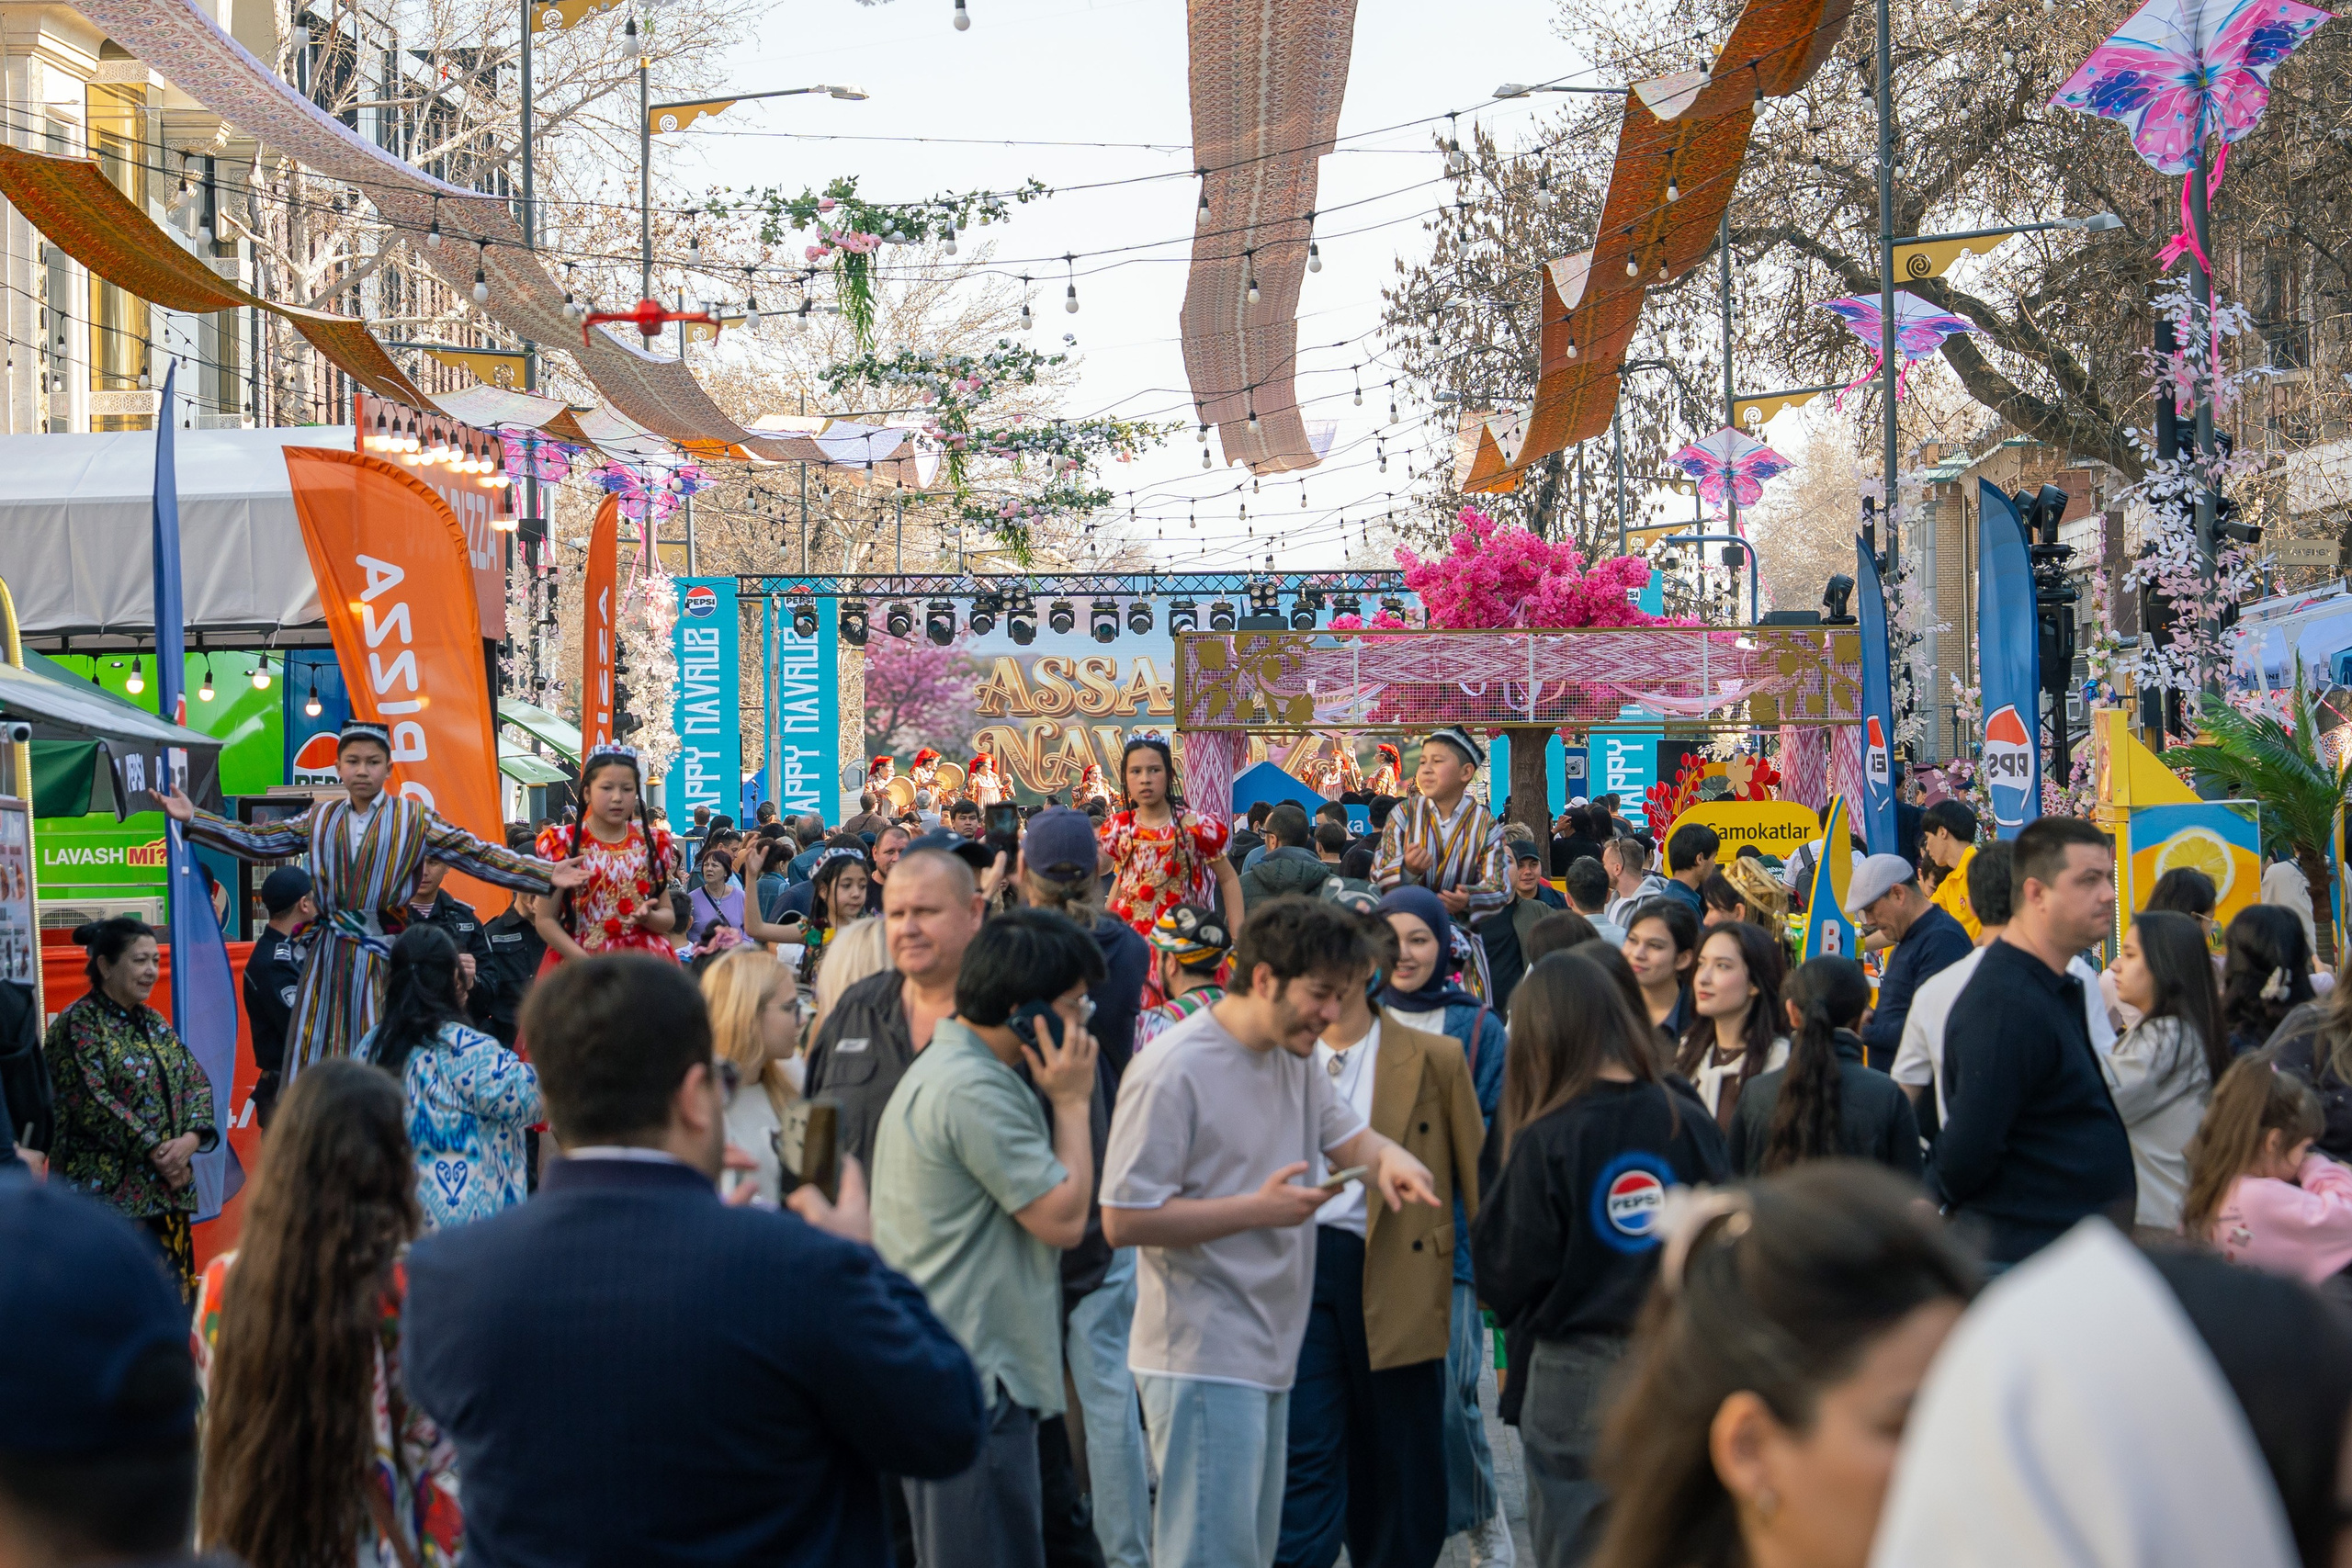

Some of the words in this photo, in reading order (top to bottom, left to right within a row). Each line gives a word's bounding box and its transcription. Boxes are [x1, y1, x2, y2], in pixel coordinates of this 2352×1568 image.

[684, 627, 720, 735] NAVRUZ
[973, 655, 1175, 718] ASSA
[784, 745, 820, 820] APPY
[44, 847, 124, 865] LAVASH
